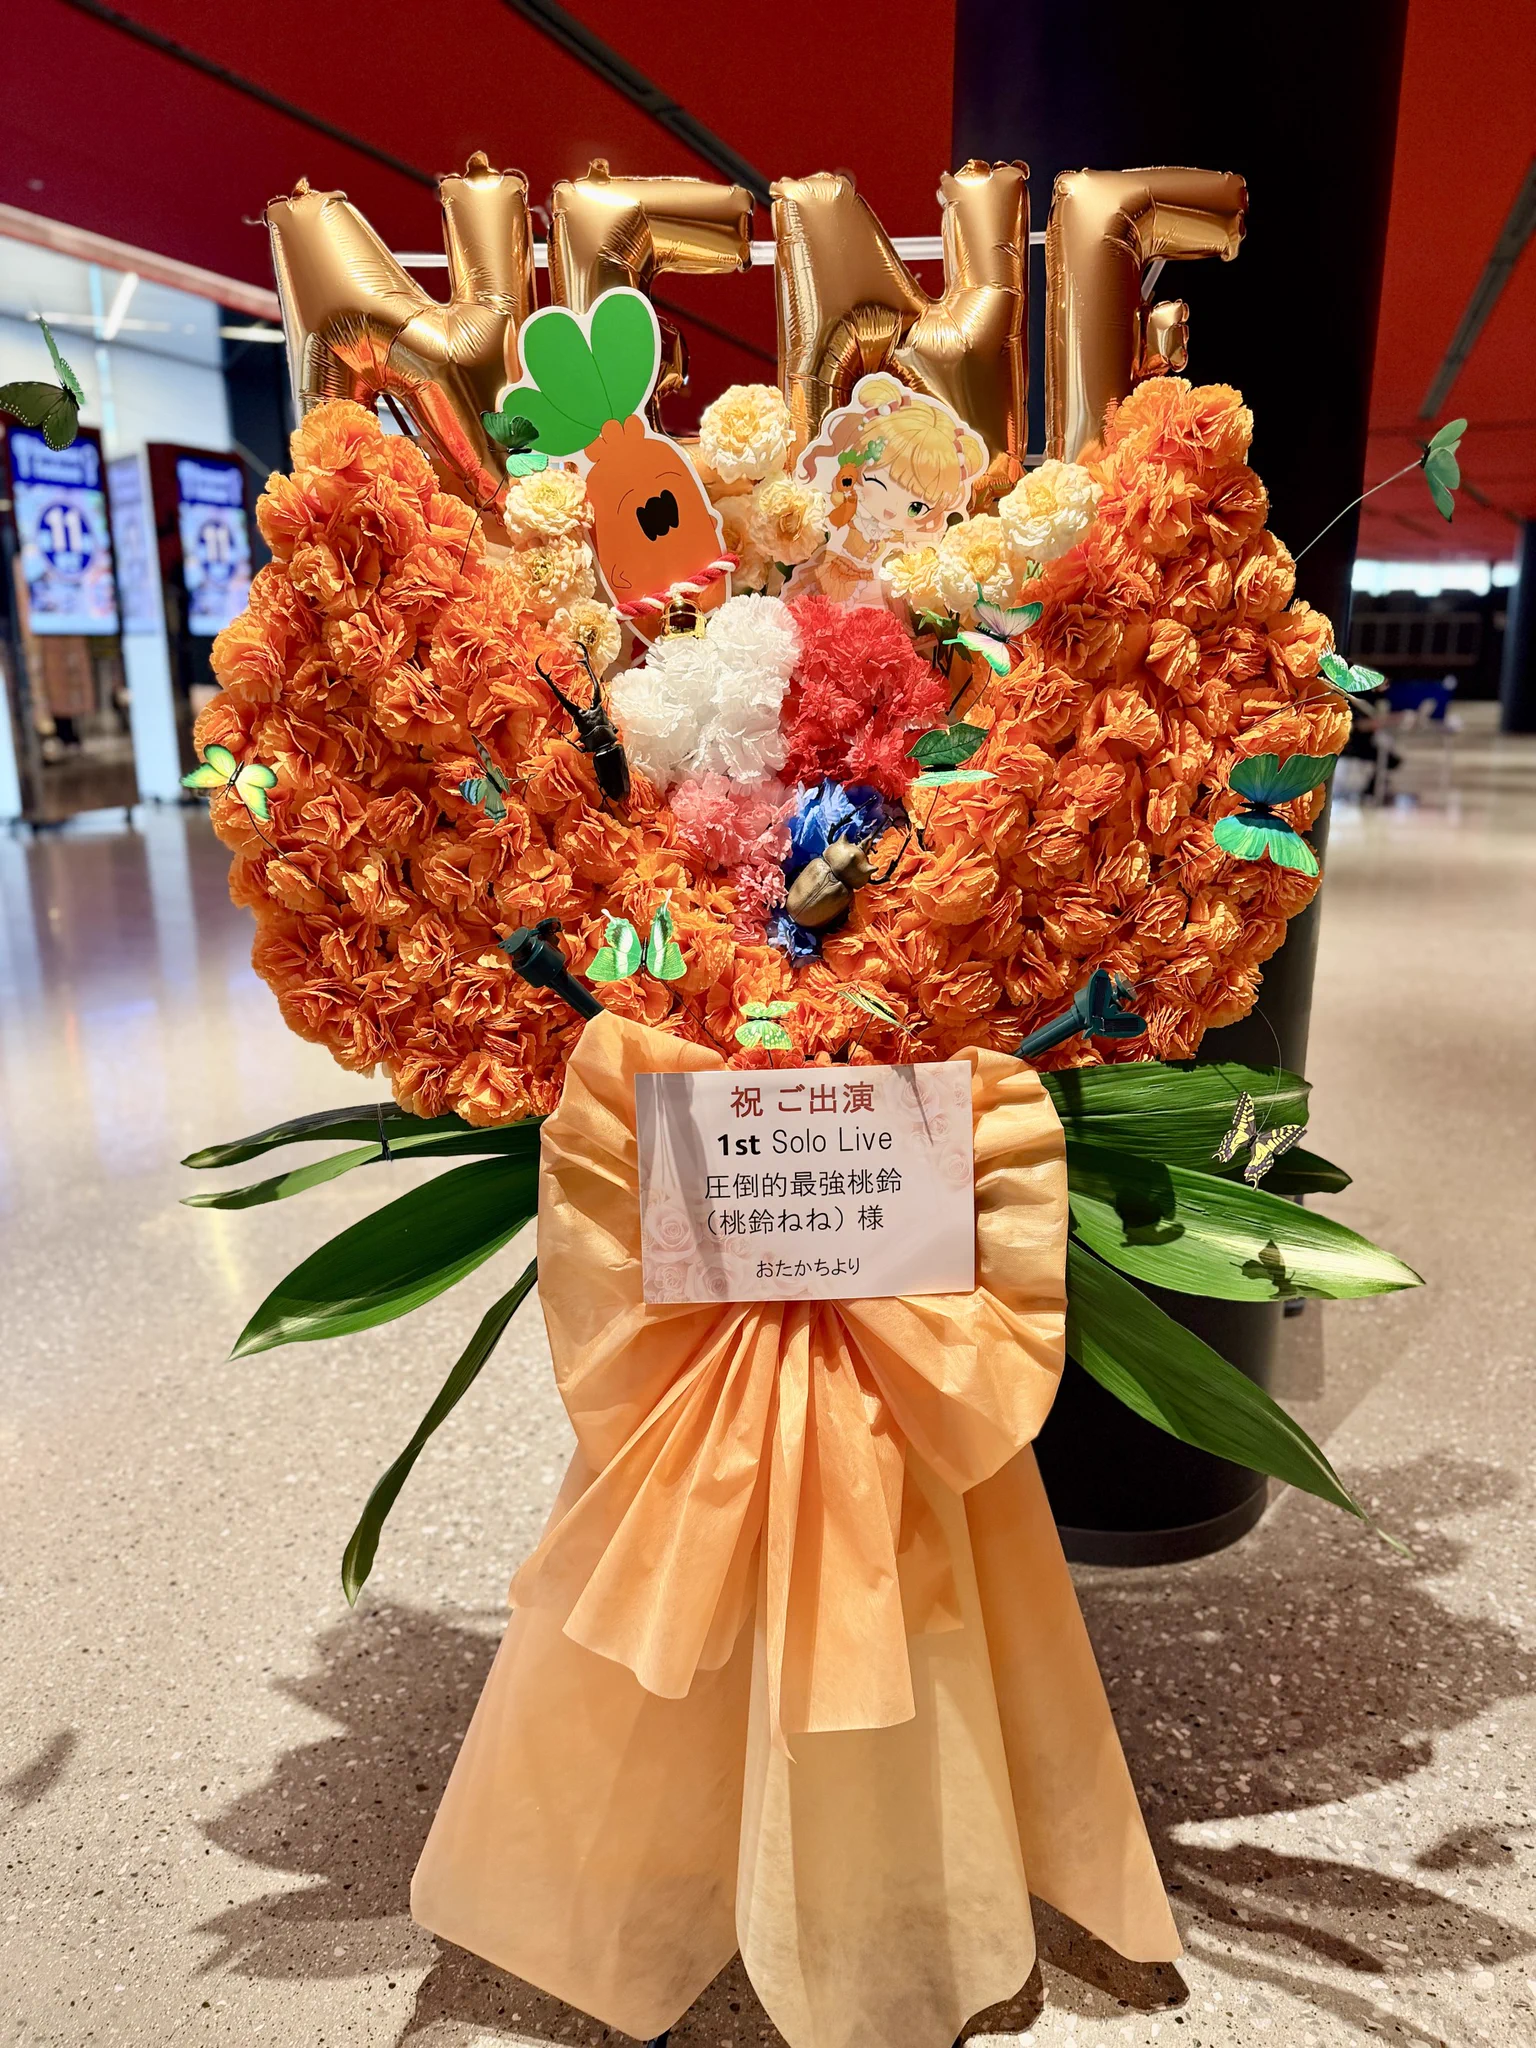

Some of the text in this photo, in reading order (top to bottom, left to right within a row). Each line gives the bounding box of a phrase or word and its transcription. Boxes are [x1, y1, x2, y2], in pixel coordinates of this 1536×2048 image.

[730, 1081, 875, 1118] 祝 ご出演
[717, 1126, 893, 1156] 1st Solo Live
[704, 1167, 903, 1200] 圧倒的最強桃鈴
[857, 1204, 884, 1231] 様
[756, 1257, 861, 1279] おたかちより
